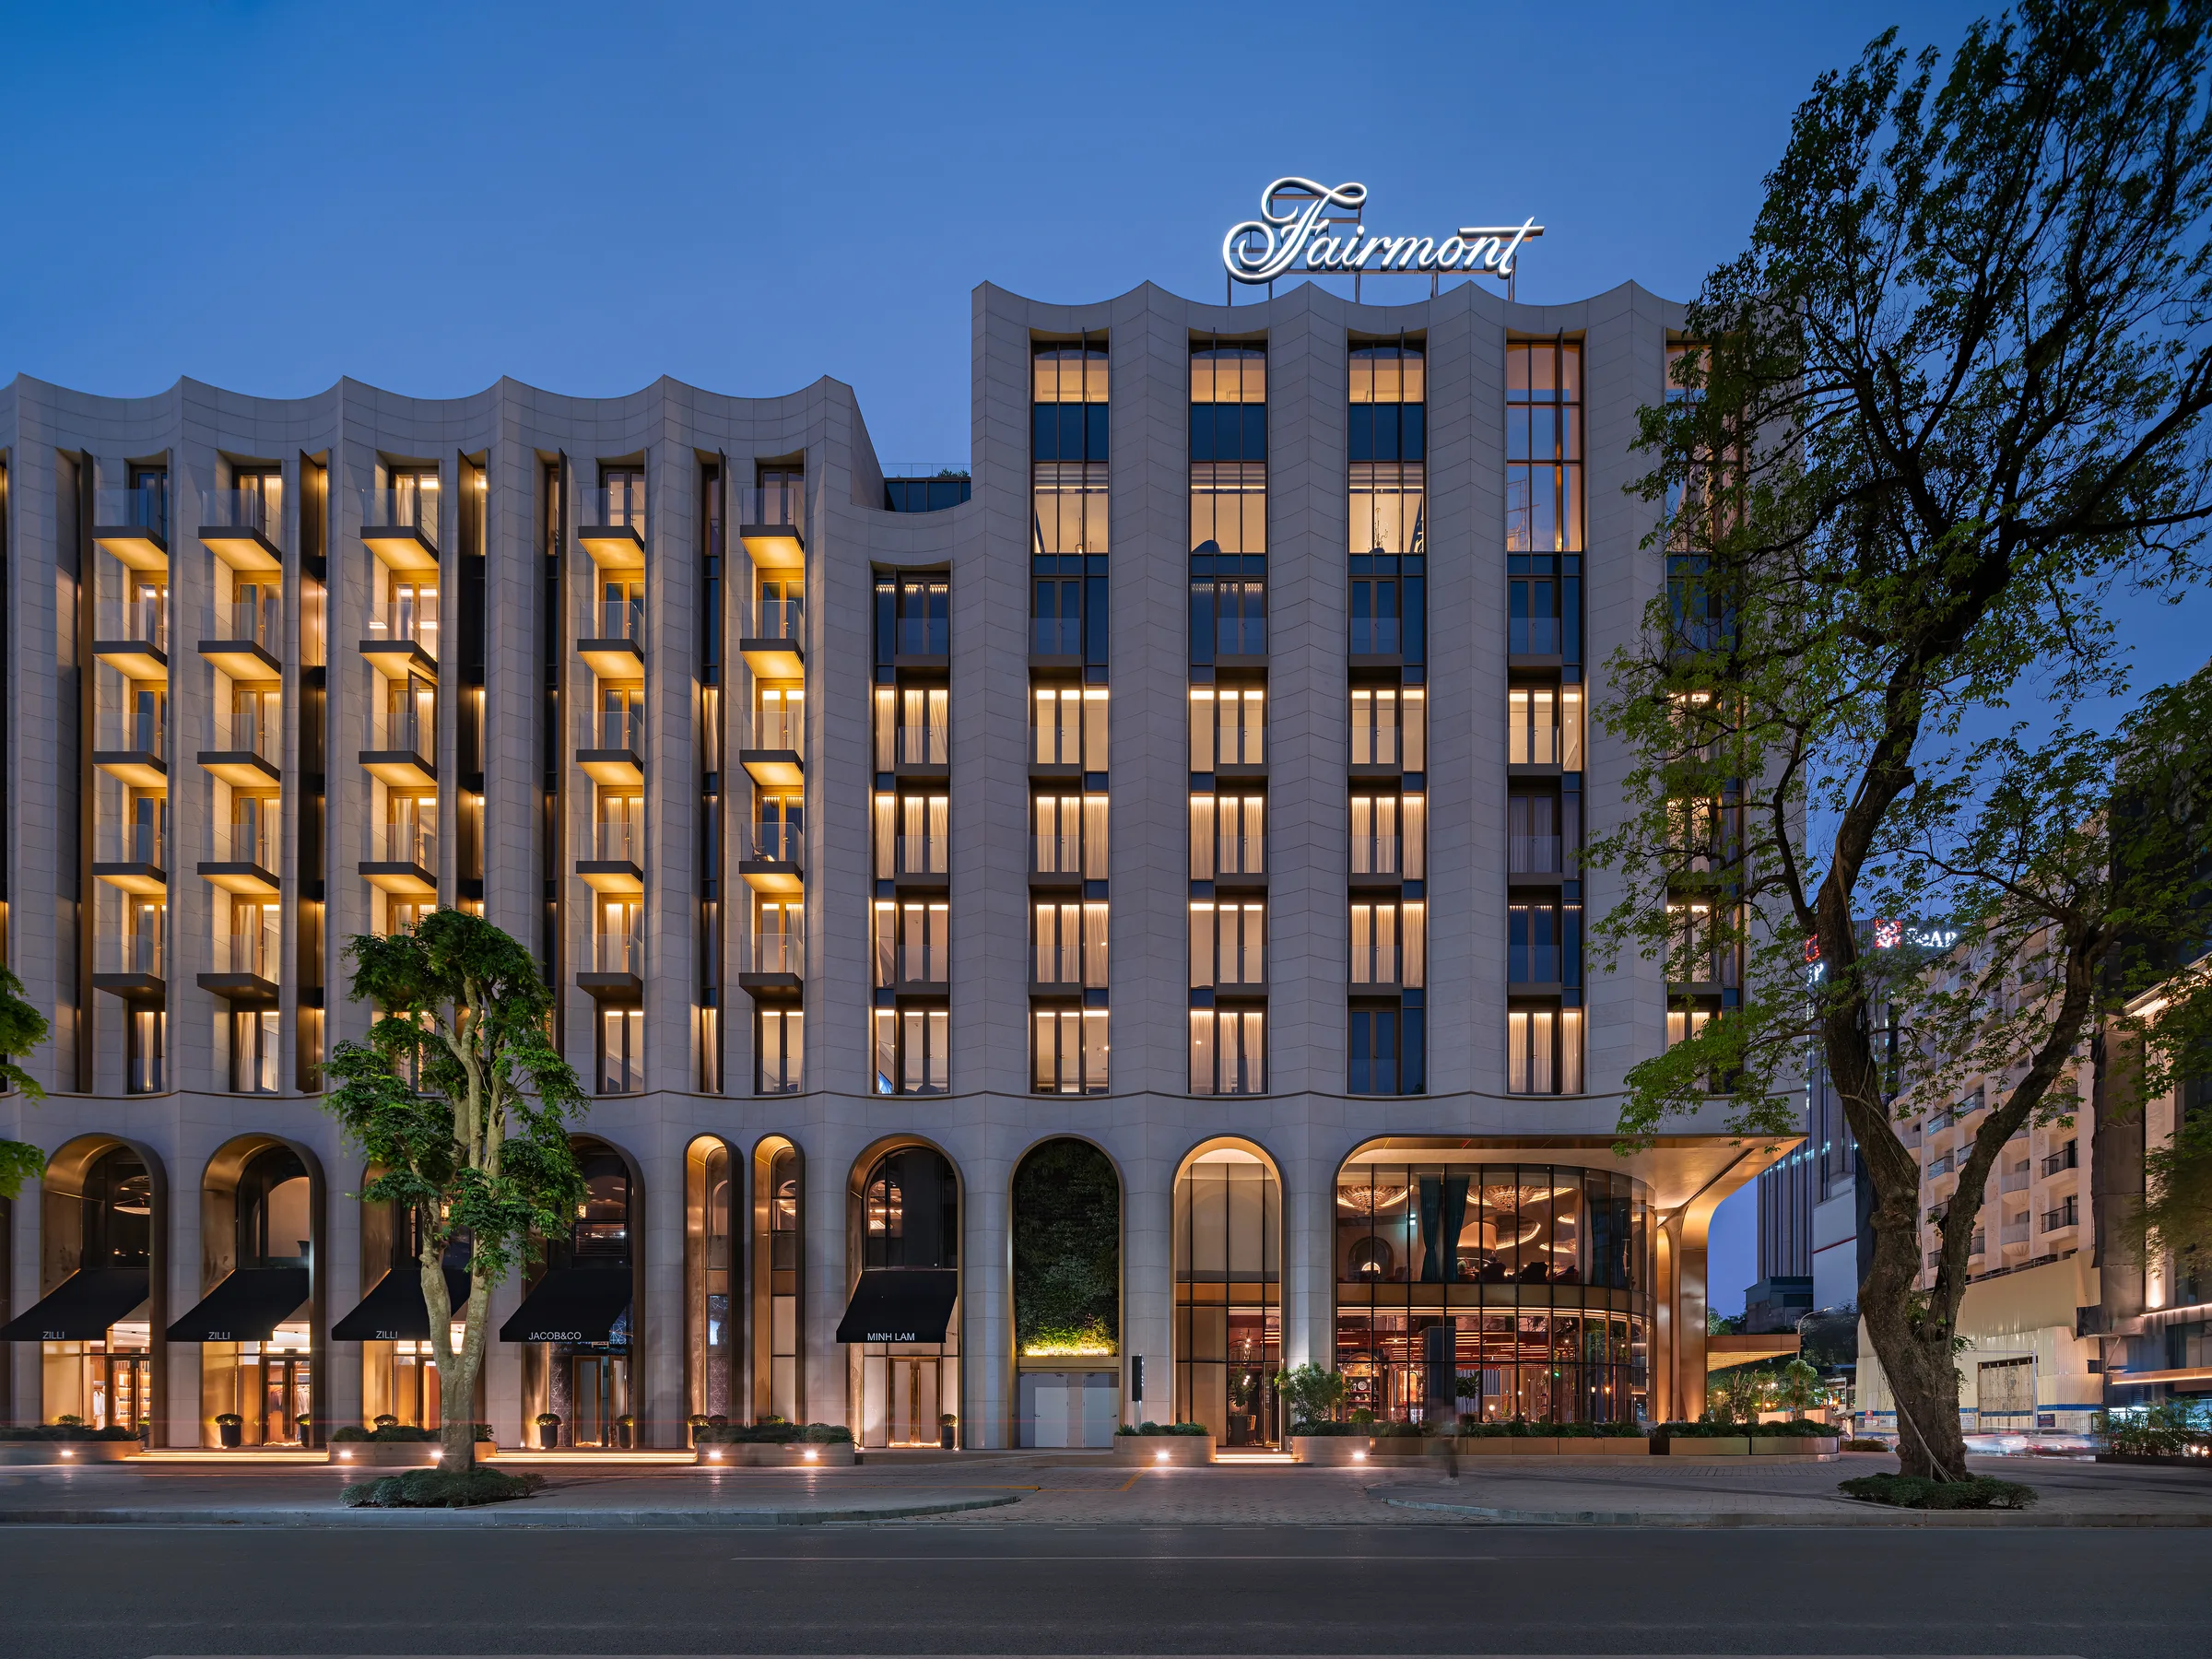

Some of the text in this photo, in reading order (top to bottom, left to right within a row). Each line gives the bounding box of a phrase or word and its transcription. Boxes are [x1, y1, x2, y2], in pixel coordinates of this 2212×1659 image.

[1222, 176, 1545, 285] Fairmont
[42, 1331, 65, 1340] ZILLI
[207, 1331, 230, 1340] ZILLI
[375, 1330, 398, 1339] ZILLI
[528, 1331, 582, 1340] JACOB&CO
[867, 1333, 915, 1341] MINH LAM
